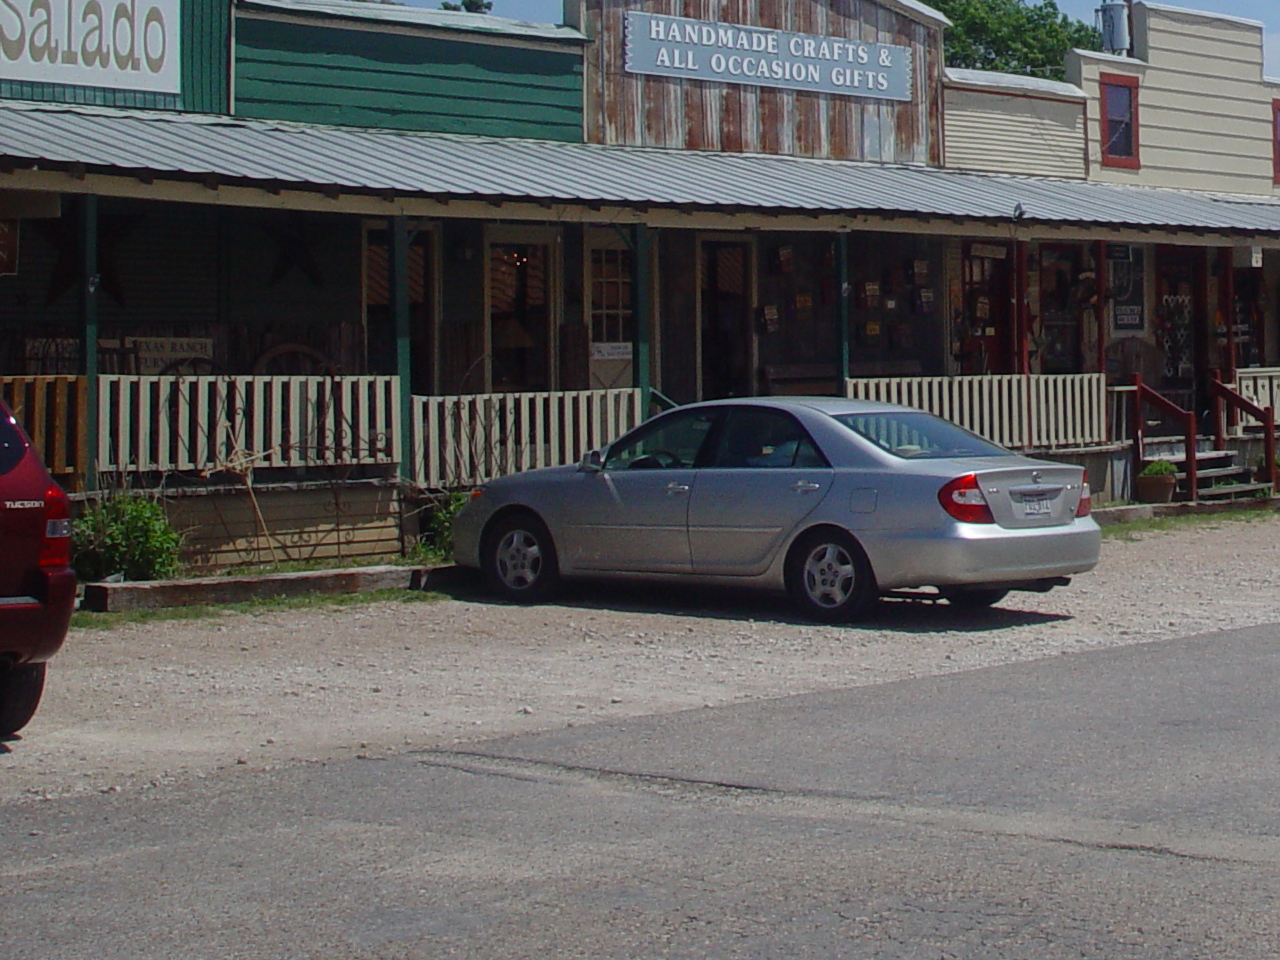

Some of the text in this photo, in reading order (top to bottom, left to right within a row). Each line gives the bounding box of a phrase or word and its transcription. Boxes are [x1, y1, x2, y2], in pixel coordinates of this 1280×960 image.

[650, 19, 893, 68] HANDMADE CRAFTS &
[656, 47, 889, 90] ALL OCCASION GIFTS
[170, 340, 208, 354] RANCH
[4, 500, 45, 509] TUCSON
